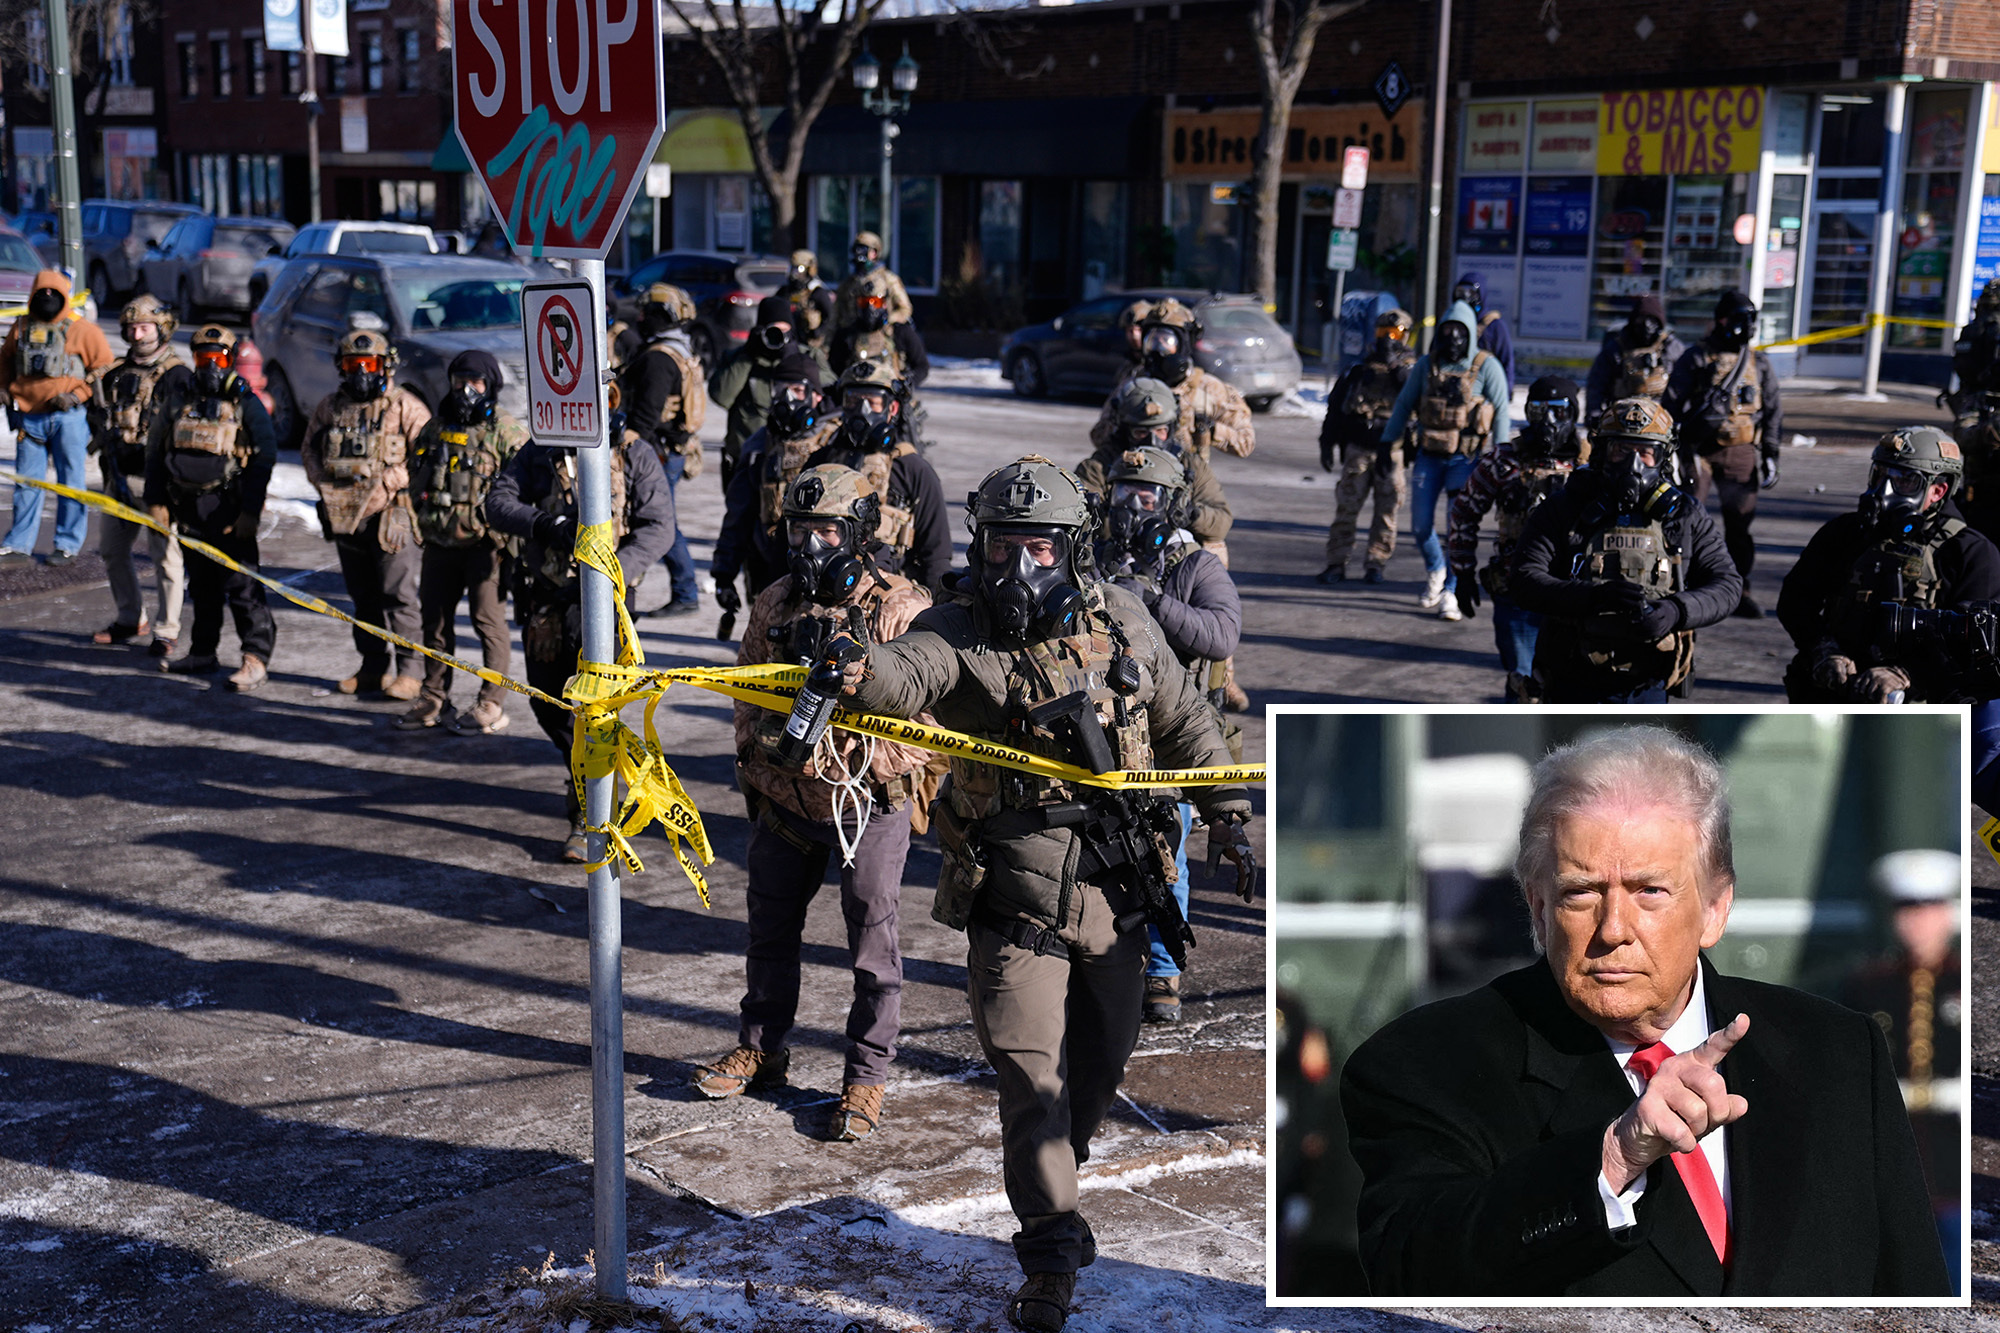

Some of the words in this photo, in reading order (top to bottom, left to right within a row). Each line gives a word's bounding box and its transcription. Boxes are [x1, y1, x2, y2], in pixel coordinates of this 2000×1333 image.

[468, 0, 638, 117] STOP
[1602, 86, 1760, 134] TOBACCO
[1191, 127, 1260, 163] Stre
[1623, 135, 1643, 175] &
[1660, 132, 1732, 174] MAS
[536, 400, 554, 430] 30
[560, 402, 593, 432] FEET
[1606, 536, 1652, 549] POLICE
[1062, 671, 1109, 693] OLICE
[855, 713, 897, 735] LINE
[900, 726, 926, 742] DO
[929, 732, 969, 750] NOT
